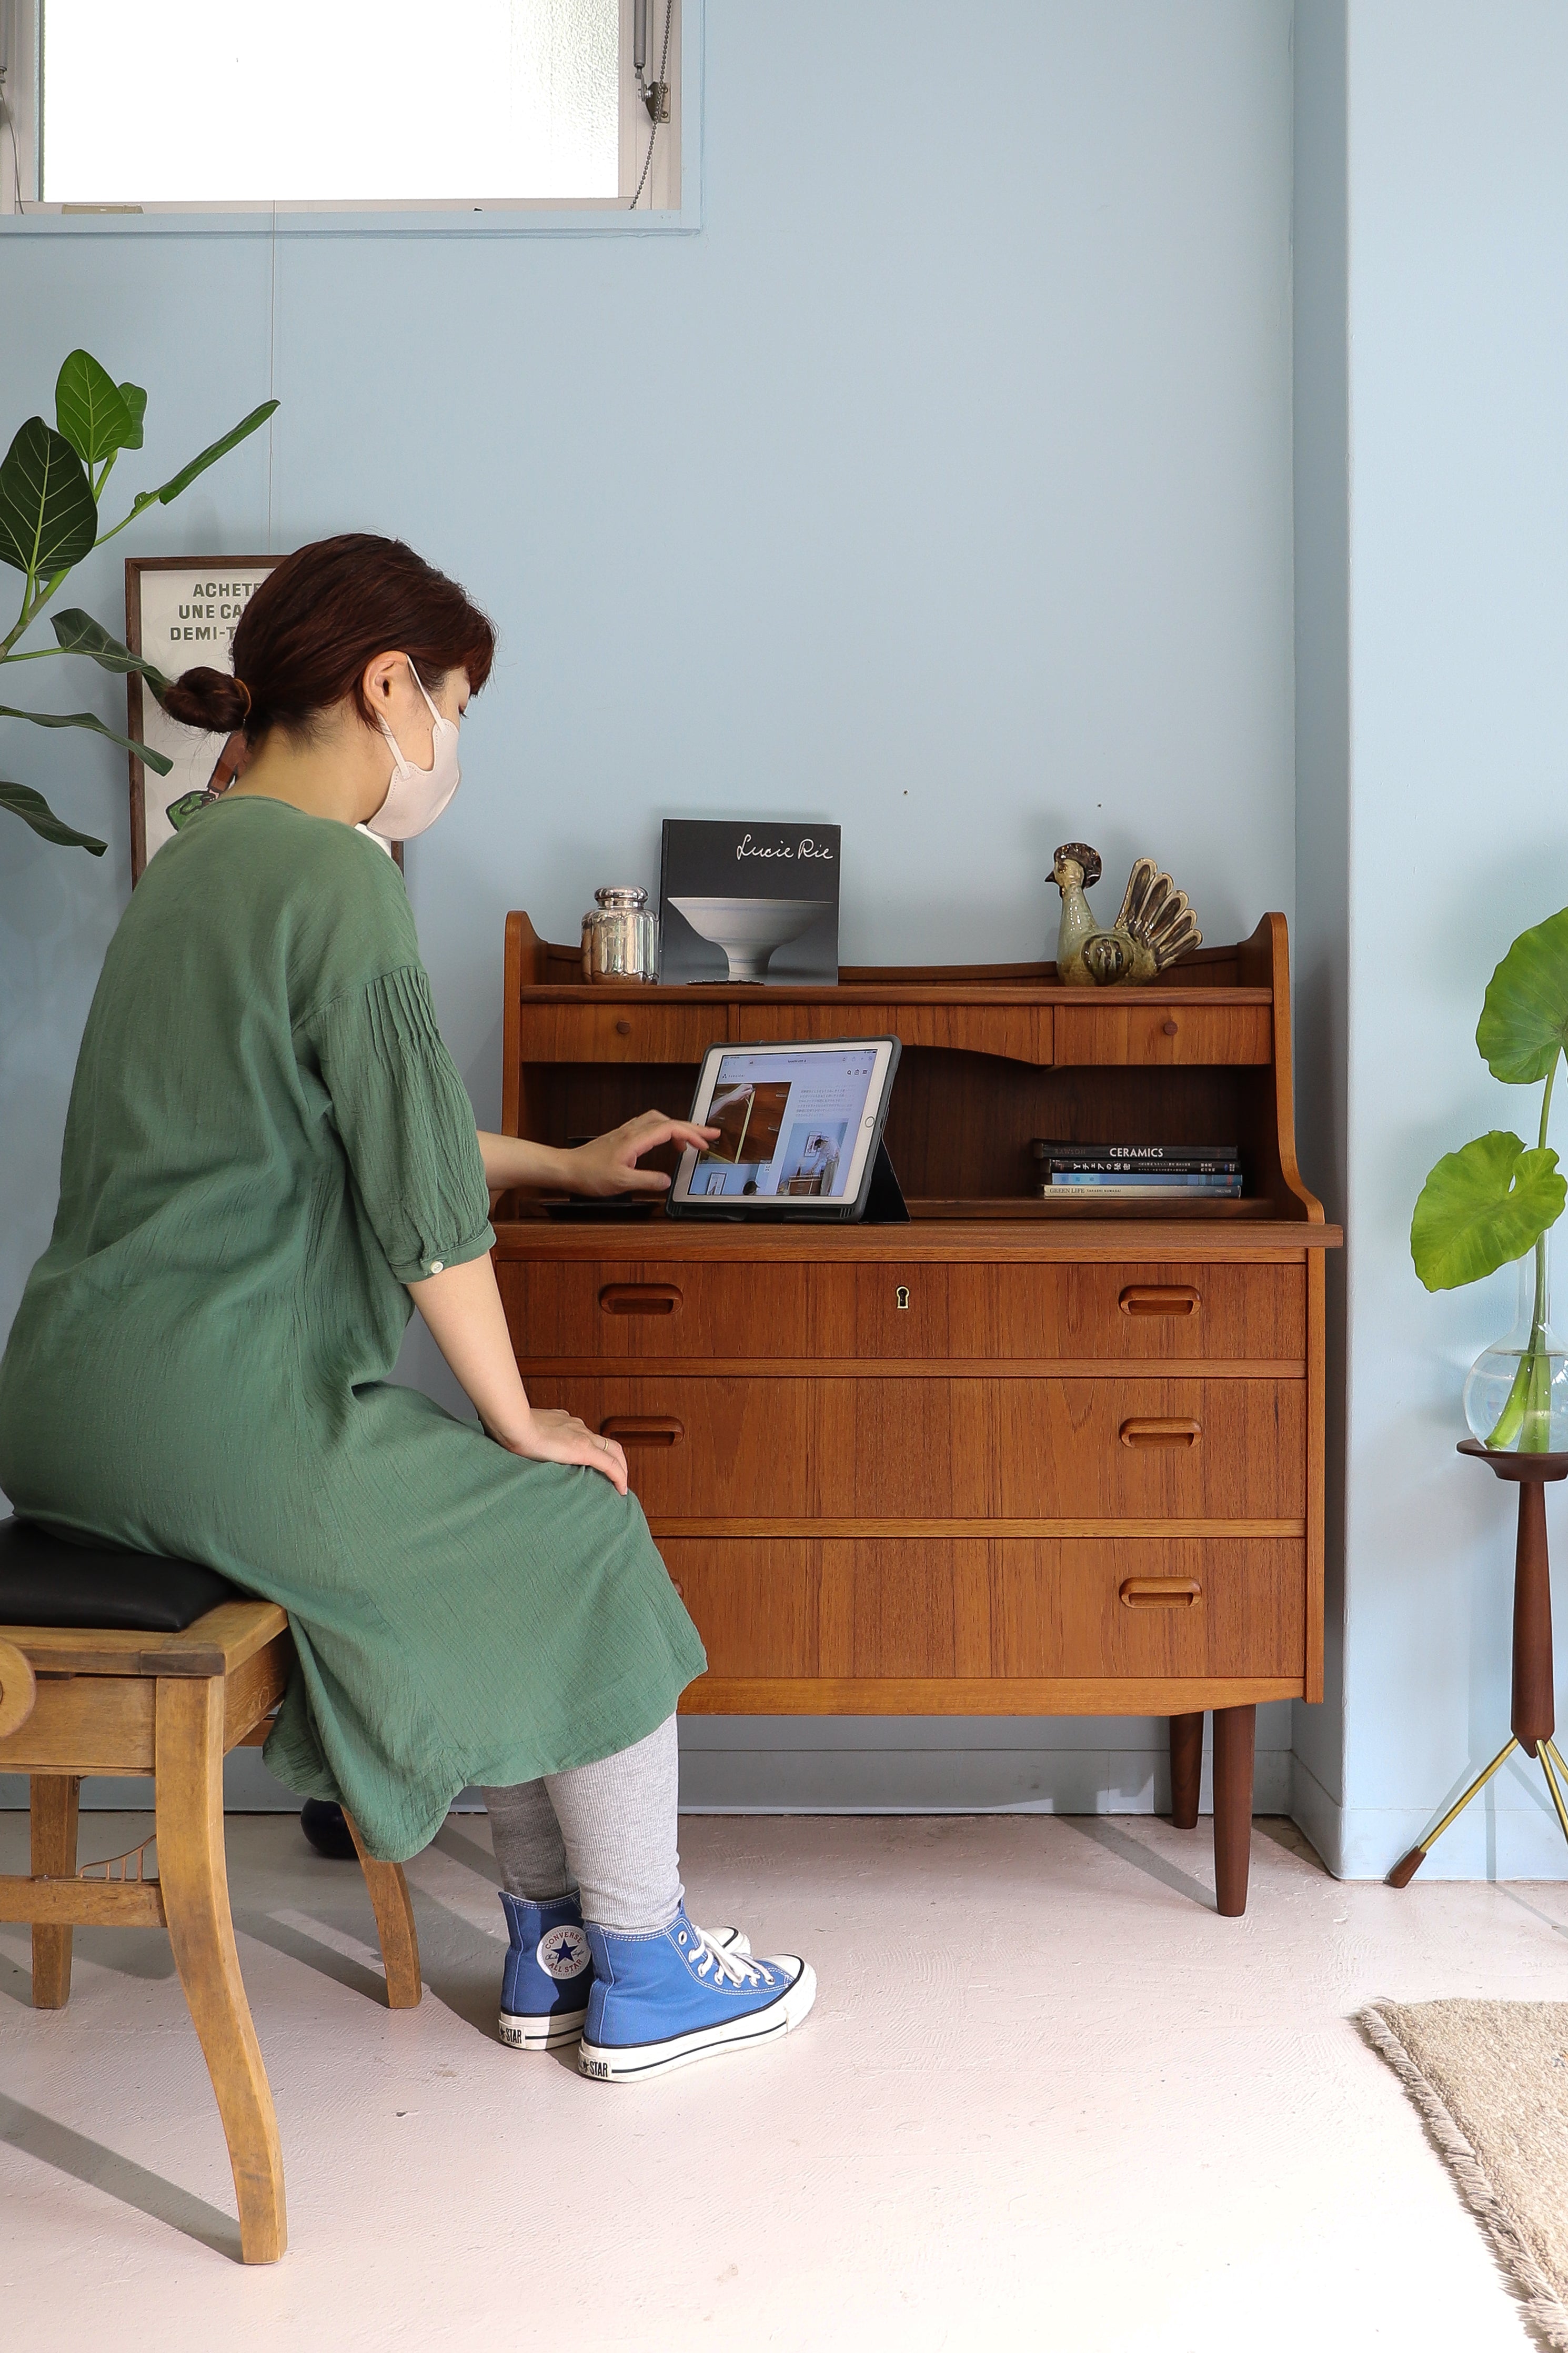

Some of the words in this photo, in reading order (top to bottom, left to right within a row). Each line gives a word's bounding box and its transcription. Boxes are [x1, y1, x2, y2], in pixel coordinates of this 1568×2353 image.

[179, 605, 215, 619] UNE
[220, 604, 248, 619] CA
[737, 834, 794, 860] Lucie
[798, 839, 833, 859] Rie
[1109, 1148, 1163, 1157] CERAMICS
[545, 1932, 582, 1949] CONVERSE
[549, 1963, 562, 1972] ALL
[564, 1959, 582, 1973] STAR
[506, 2028, 521, 2044] STAR
[590, 2060, 608, 2077] STAR
